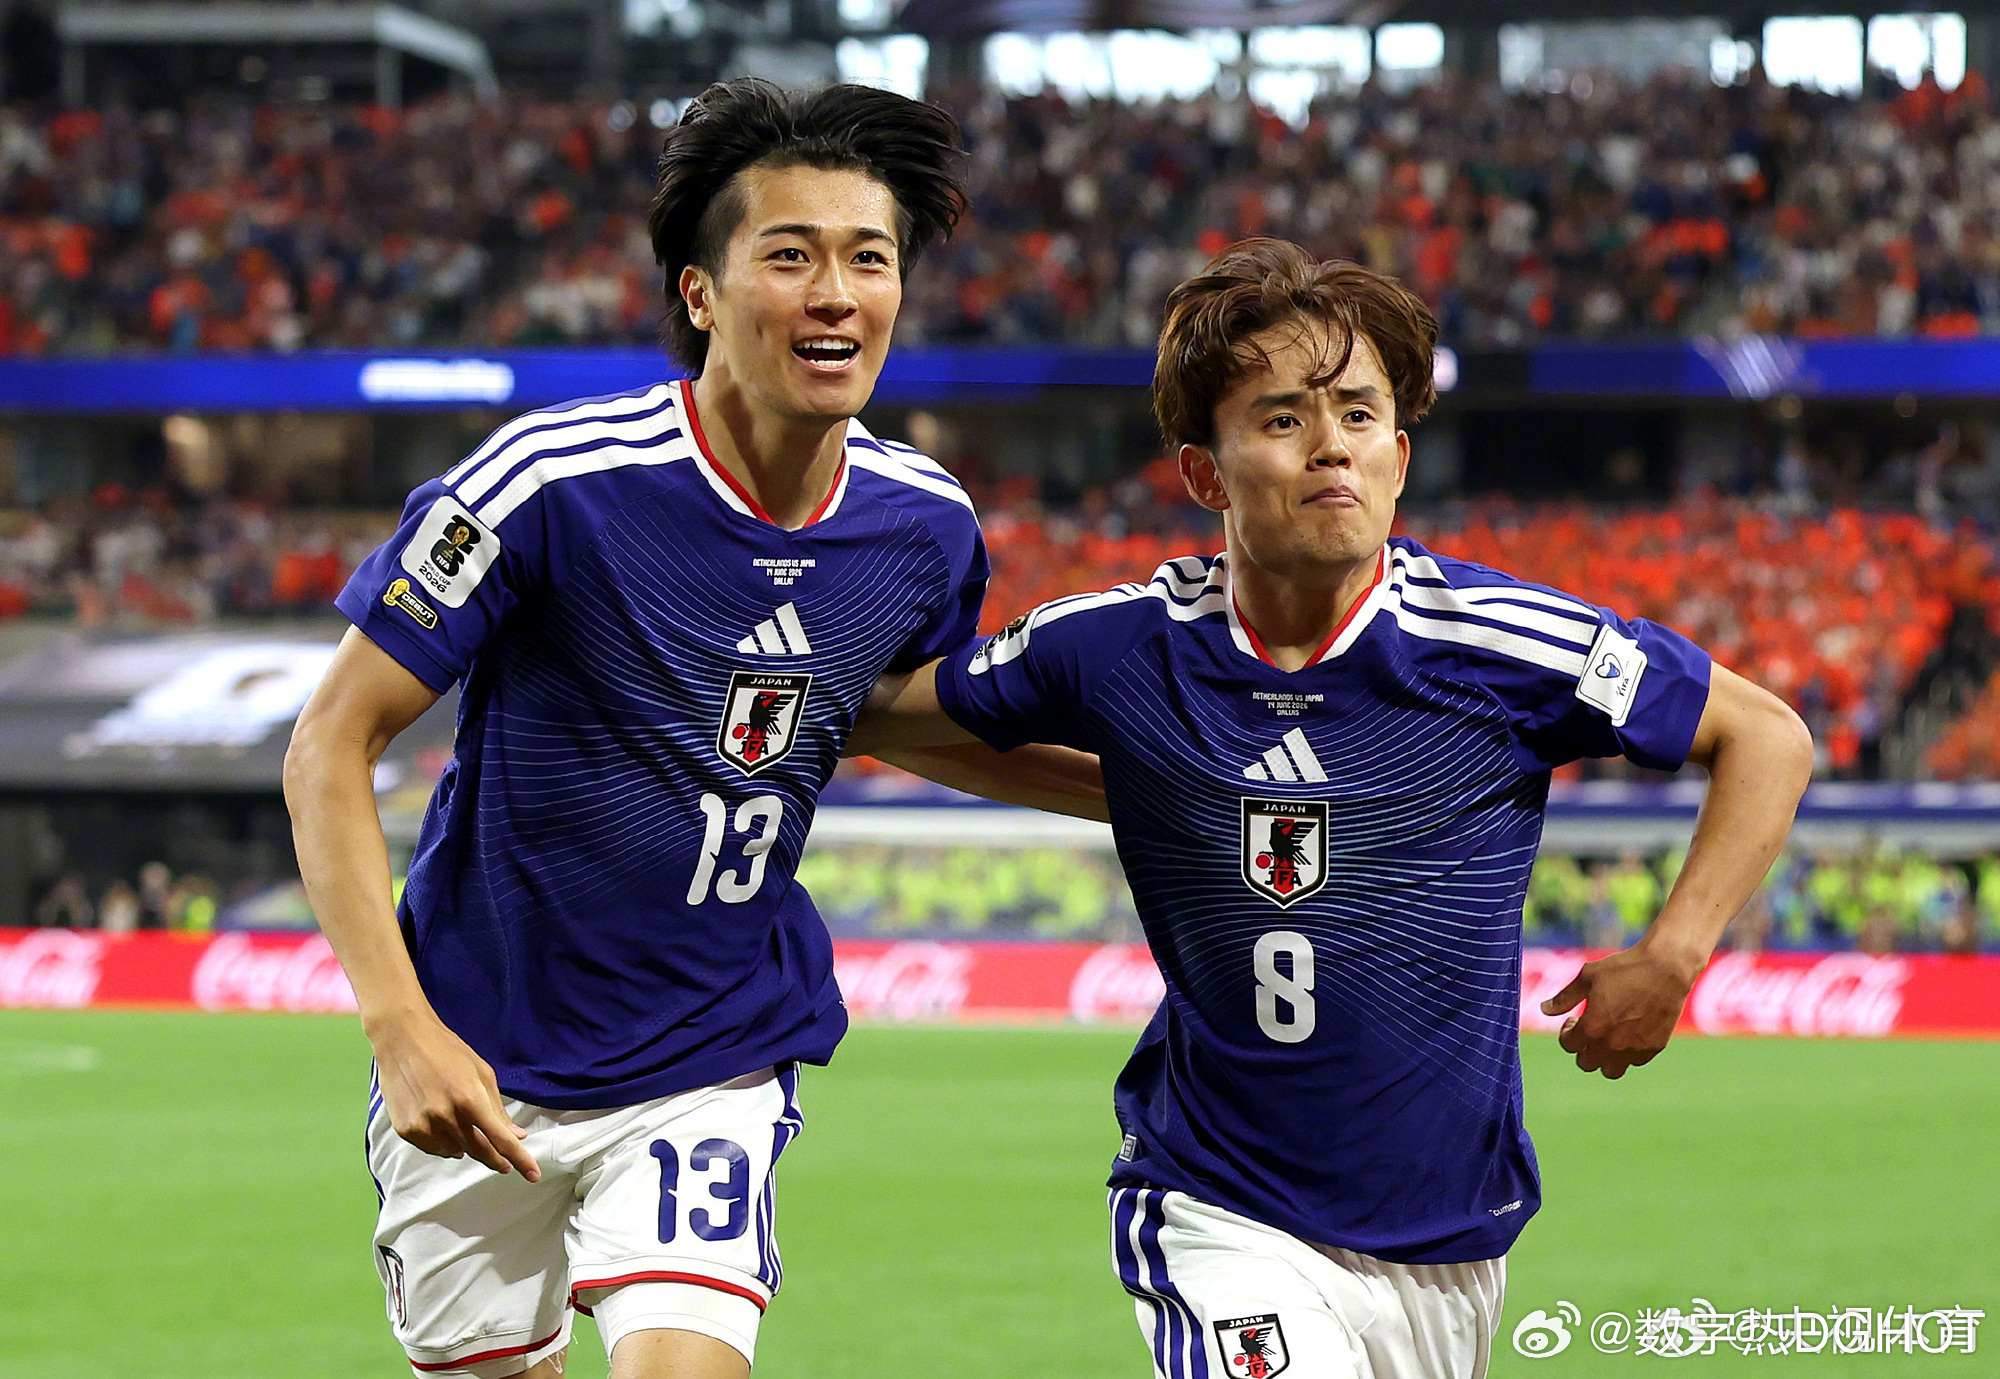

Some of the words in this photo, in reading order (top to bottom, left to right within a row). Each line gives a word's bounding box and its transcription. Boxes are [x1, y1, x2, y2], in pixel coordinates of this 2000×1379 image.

[436, 555, 450, 571] FIFA
[800, 559, 816, 567] JAPAN
[419, 565, 447, 593] 2026
[424, 560, 440, 578] WORLD
[439, 576, 452, 586] CUP
[773, 577, 794, 585] DALLAS
[402, 592, 434, 620] DEBUT
[750, 677, 792, 686] JAPAN
[1252, 691, 1294, 701] NETHERLANDS
[1305, 694, 1324, 702] JAPAN
[1291, 701, 1308, 710] 2026
[735, 740, 770, 756] JFA
[1262, 803, 1306, 813] JAPAN
[686, 792, 784, 906] 13
[1264, 870, 1302, 887] JFA
[1253, 930, 1316, 1043] 8
[649, 1138, 750, 1245] 13
[1228, 1316, 1264, 1328] JAPAN
[1245, 1361, 1274, 1377] JFA
